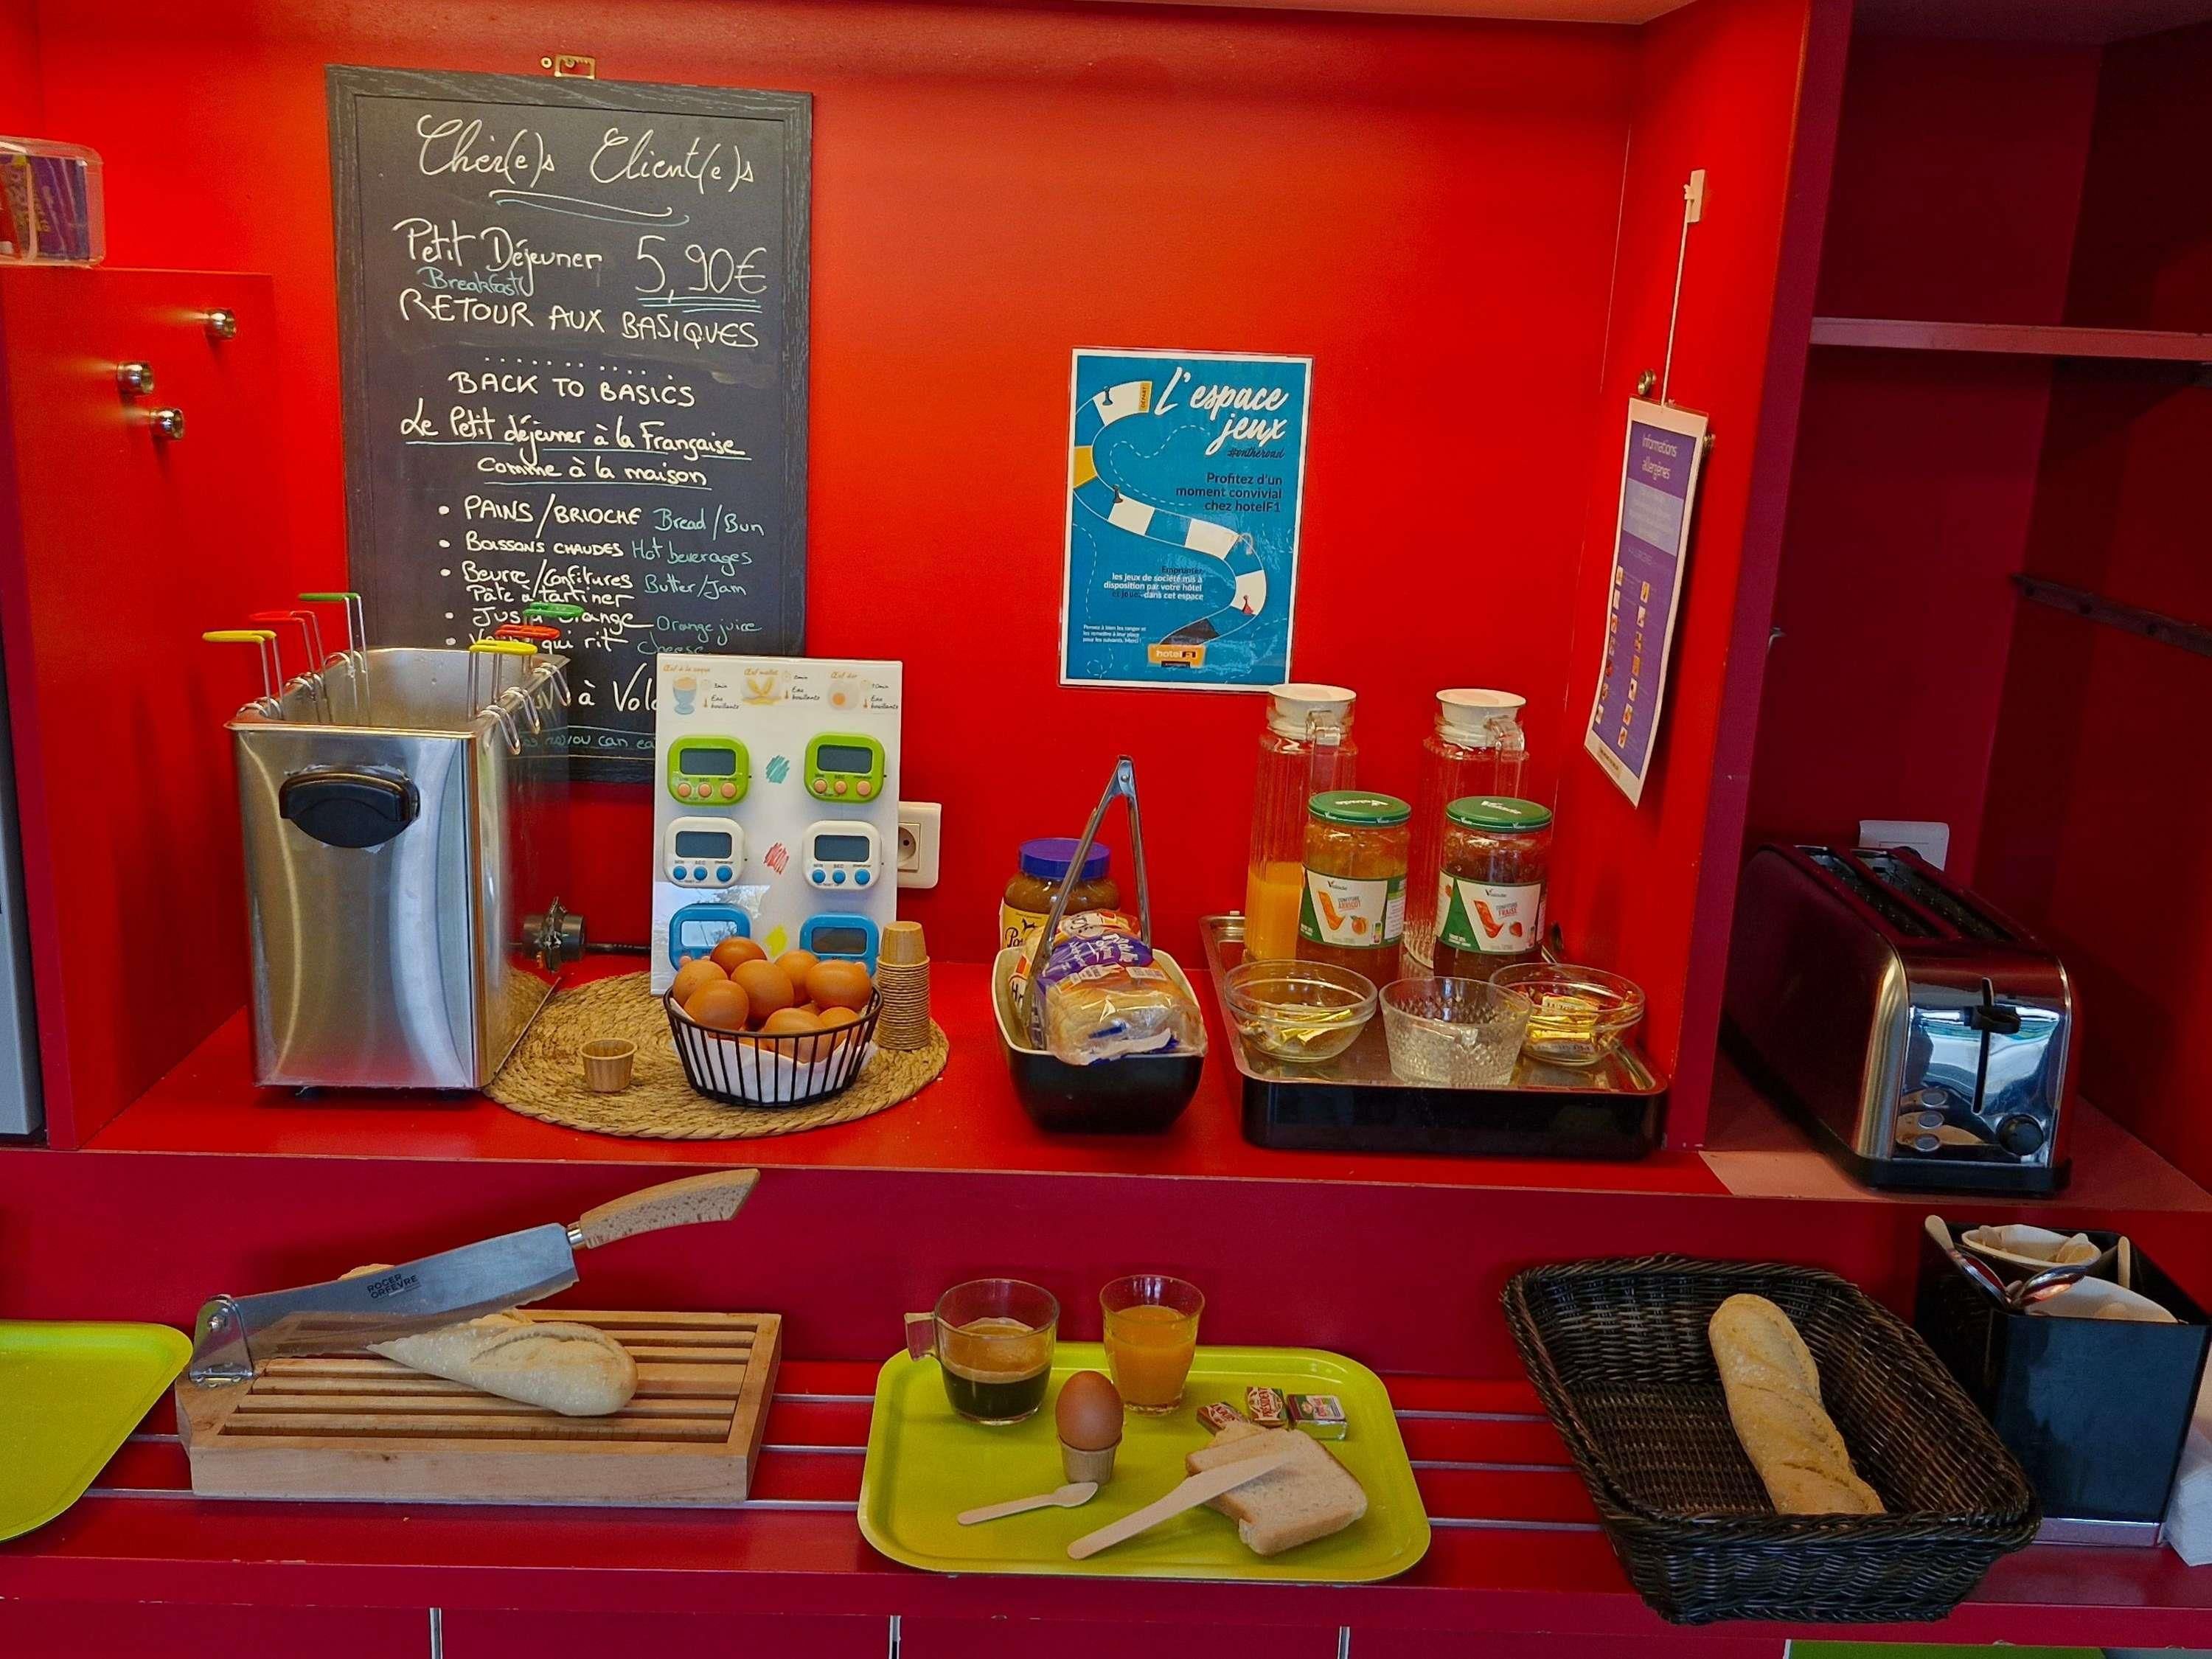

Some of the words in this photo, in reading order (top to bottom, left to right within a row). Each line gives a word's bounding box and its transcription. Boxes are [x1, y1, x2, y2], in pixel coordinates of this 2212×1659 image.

[392, 218, 476, 267] Petit
[480, 226, 602, 297] Déjeuner
[417, 266, 521, 296] Breakfast
[400, 288, 535, 327] RETOUR
[549, 305, 605, 333] AUX
[622, 310, 759, 350] BASIQUES
[448, 371, 538, 396] BACK
[552, 378, 585, 398] TO
[600, 377, 695, 407] BASICS
[400, 397, 439, 436] Le
[450, 406, 496, 440] Petit
[504, 414, 585, 466] déjeuner
[594, 423, 609, 446] à
[615, 414, 636, 448] la
[639, 420, 746, 461] Française
[1204, 413, 1288, 456] jeux
[569, 456, 587, 478] à
[595, 455, 616, 479] la
[624, 462, 708, 486] maison
[1206, 472, 1253, 484] Profitez
[1256, 473, 1283, 485] d'un
[1175, 487, 1226, 498] moment
[1229, 488, 1281, 499] convivial
[1204, 499, 1232, 512] chez
[1235, 500, 1281, 512] hotelF1
[553, 542, 624, 557] CHAUDES
[631, 537, 663, 560] Hot
[667, 540, 753, 577] beverages
[1104, 581, 1145, 590] disposition
[1112, 572, 1123, 580] les
[1124, 573, 1141, 582] jeux
[1153, 574, 1181, 582] société
[538, 585, 635, 608] tartiner
[1178, 593, 1203, 601] espace
[473, 606, 521, 627] Jus
[656, 615, 714, 643] Orange
[717, 619, 762, 646] juice
[540, 630, 574, 655] qui
[585, 627, 629, 652] rit
[578, 679, 596, 706] à
[598, 735, 628, 748] can
